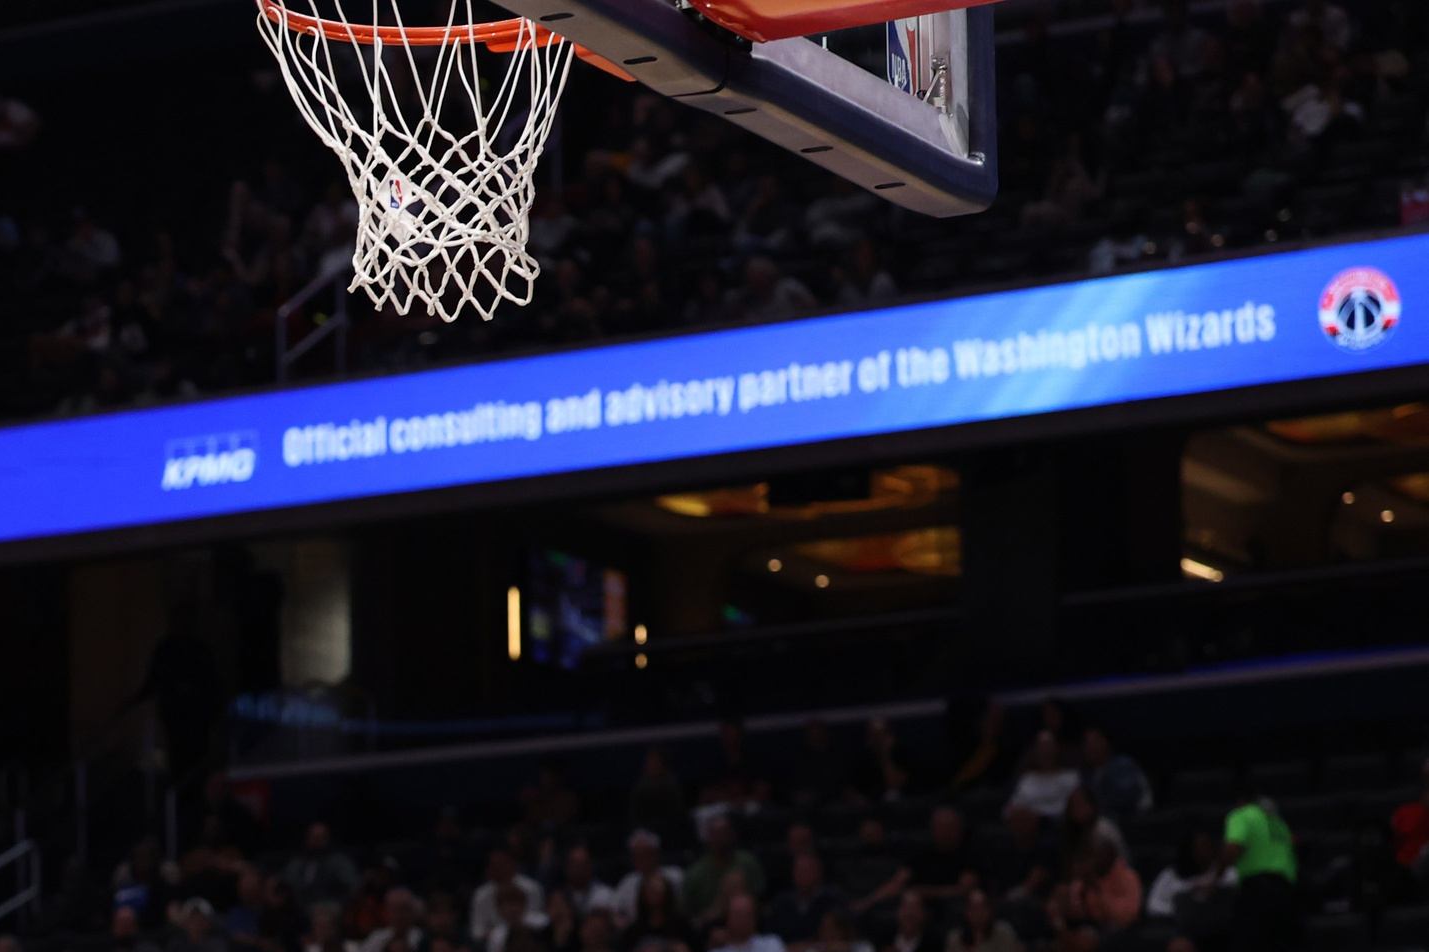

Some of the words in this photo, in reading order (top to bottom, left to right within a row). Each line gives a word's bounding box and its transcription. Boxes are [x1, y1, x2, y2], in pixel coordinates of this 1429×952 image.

[283, 415, 387, 467] Official
[389, 400, 542, 454] consulting
[545, 387, 601, 434] and
[605, 379, 734, 427] advisory
[738, 360, 853, 414] partner
[857, 350, 891, 393] of
[896, 346, 949, 388] the
[953, 322, 1141, 381] Washington
[1145, 300, 1277, 355] Wizards
[161, 447, 256, 491] KPMG
